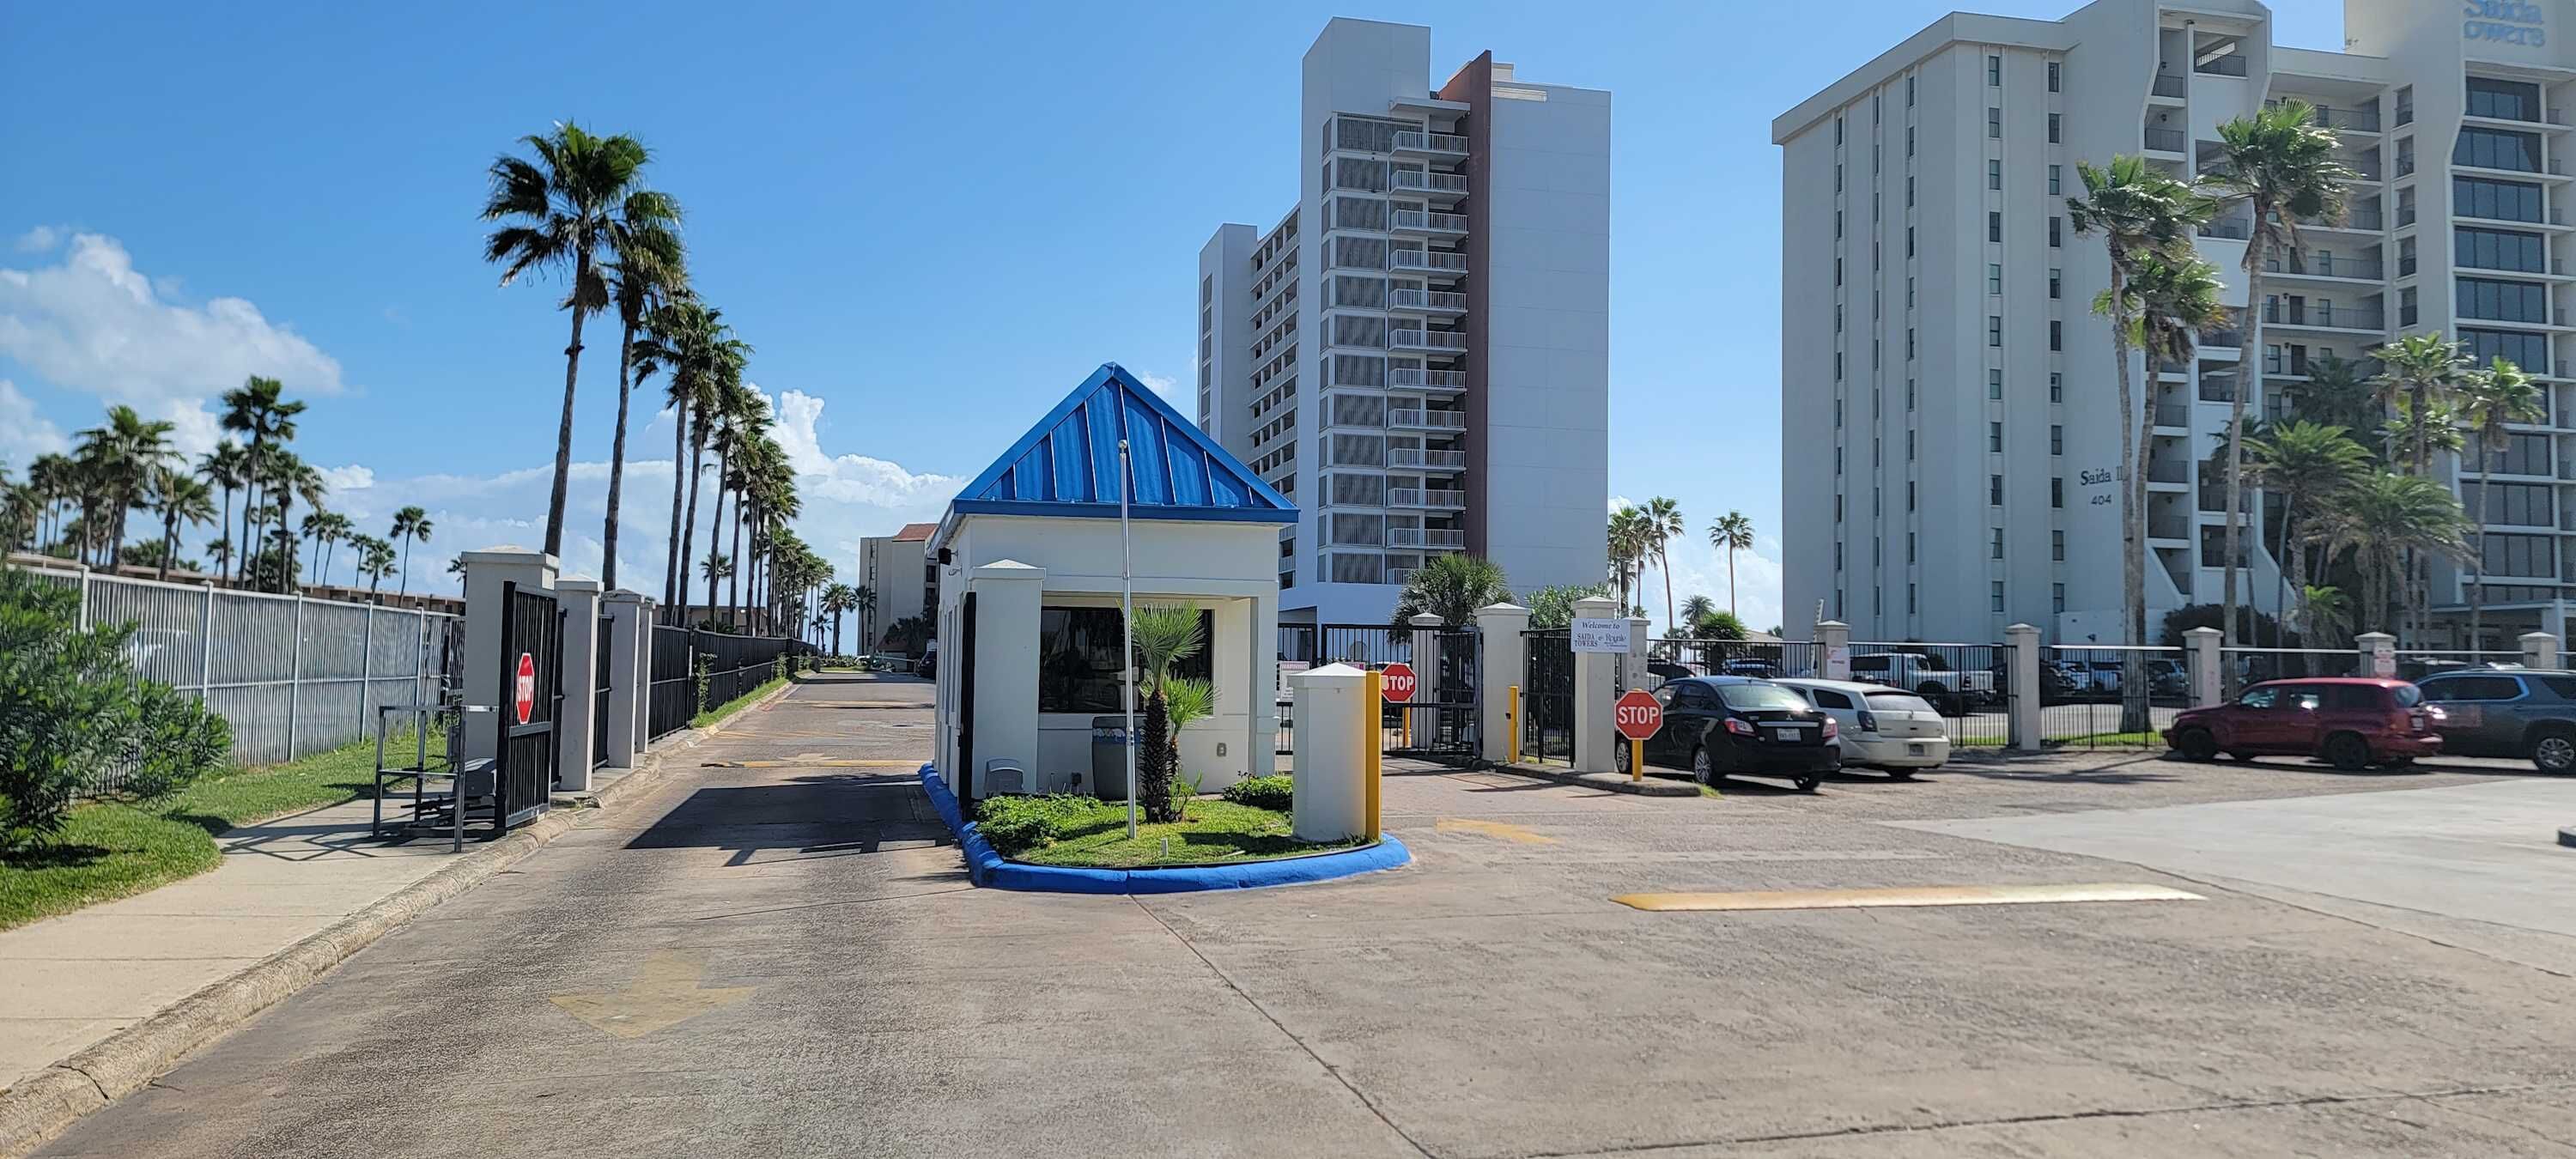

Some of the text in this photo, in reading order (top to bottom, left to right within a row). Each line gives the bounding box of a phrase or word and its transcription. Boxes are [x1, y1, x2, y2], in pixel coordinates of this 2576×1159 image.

[2081, 468, 2111, 486] Saida
[2091, 495, 2111, 506] 404
[518, 676, 533, 702] STOP
[1618, 706, 1659, 725] STOP
